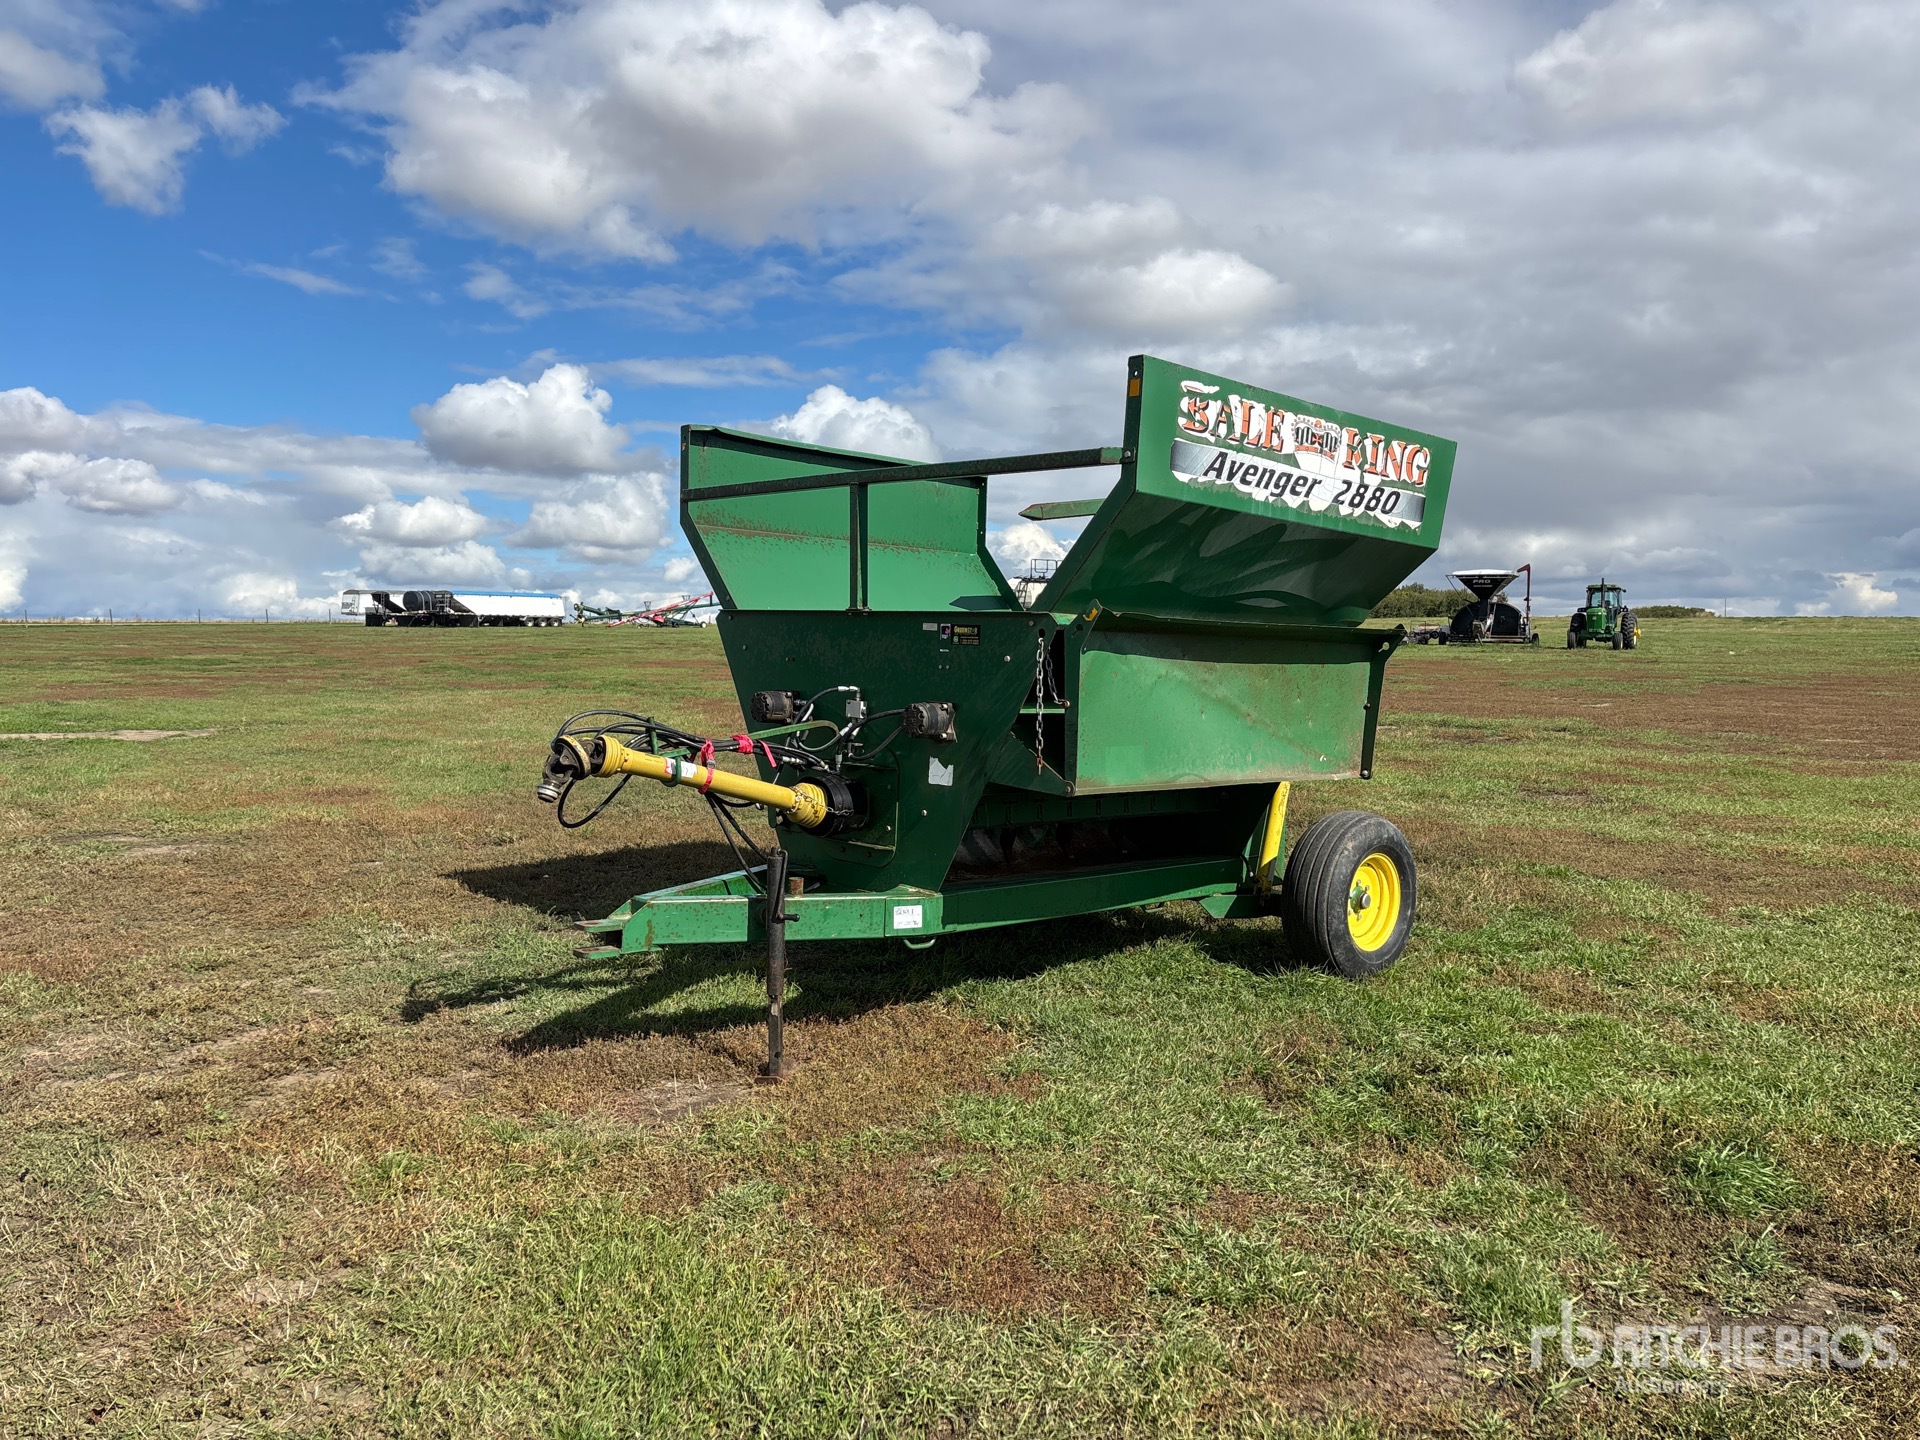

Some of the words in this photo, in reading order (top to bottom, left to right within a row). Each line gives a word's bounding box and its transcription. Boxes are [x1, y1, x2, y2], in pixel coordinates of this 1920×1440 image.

[1202, 451, 1323, 499] Avenger
[1331, 479, 1401, 515] 2880
[1342, 427, 1430, 486] KING
